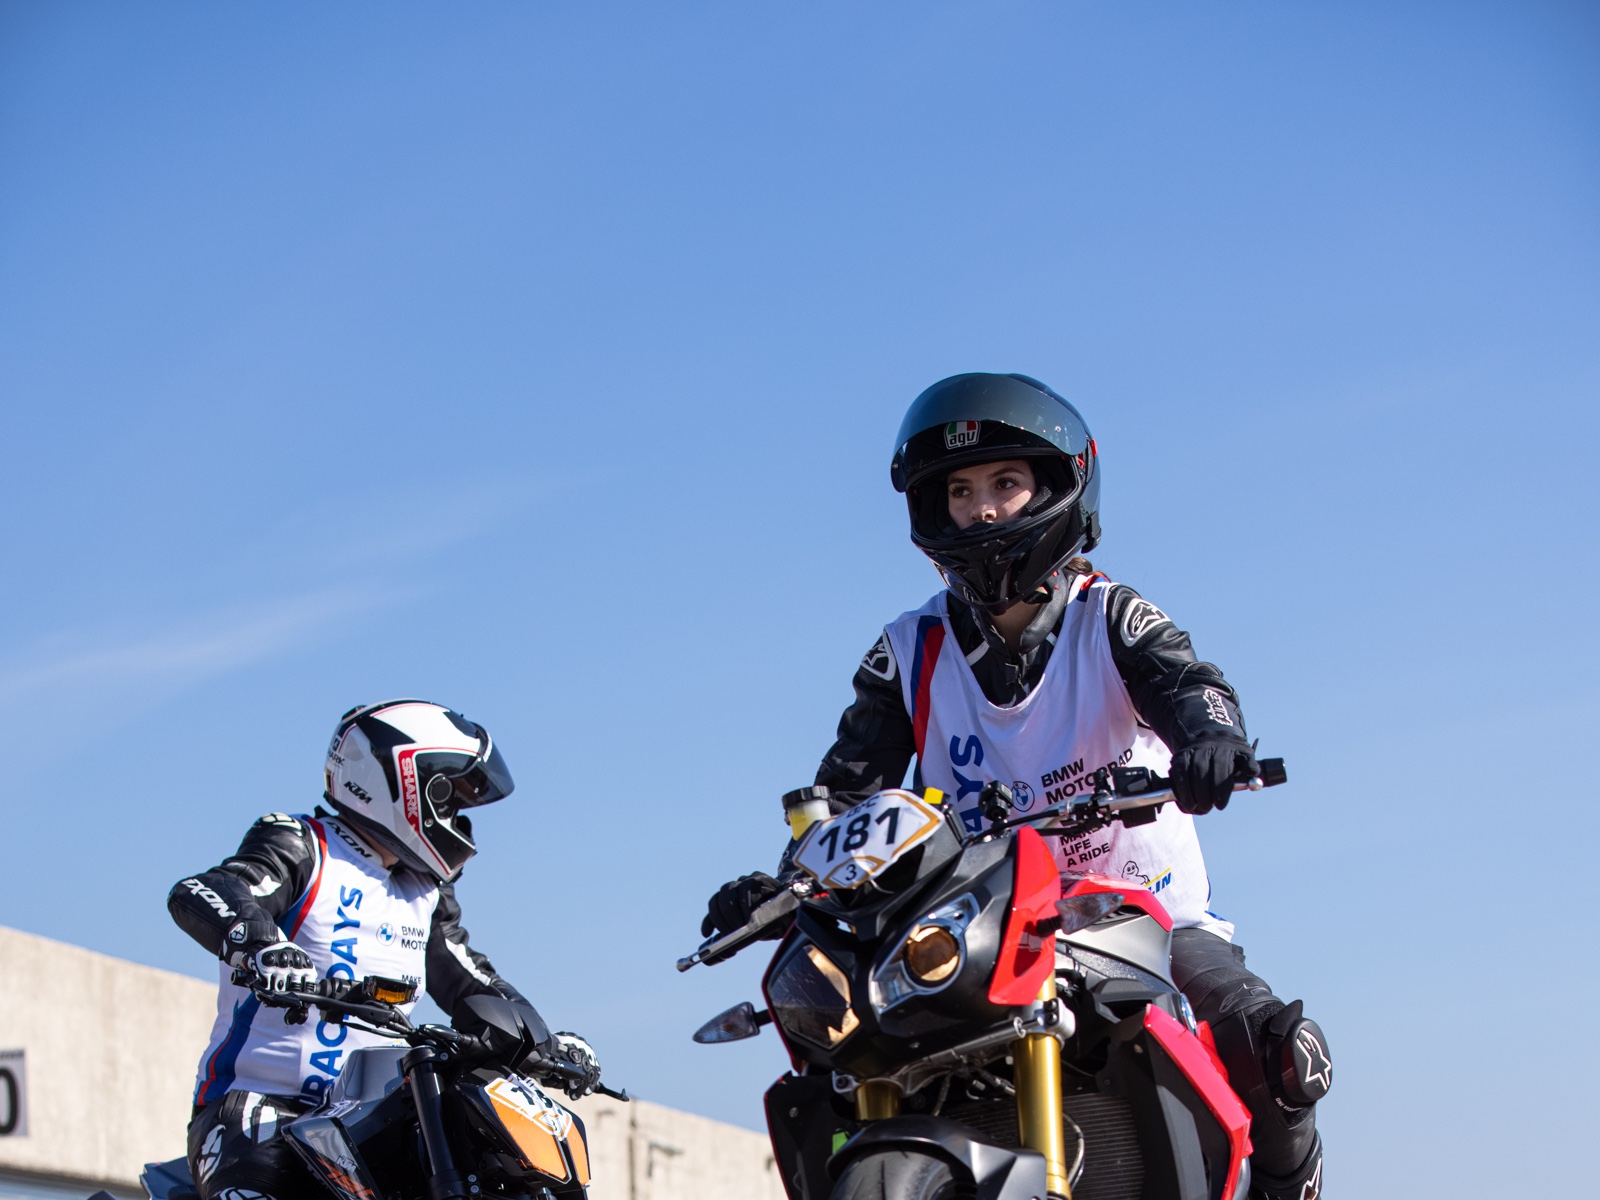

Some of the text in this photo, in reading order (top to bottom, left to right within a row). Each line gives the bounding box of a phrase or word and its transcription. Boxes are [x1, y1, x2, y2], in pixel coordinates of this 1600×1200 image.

[950, 431, 976, 446] agv
[1041, 758, 1085, 788] BMW
[344, 780, 373, 804] KTM
[401, 757, 418, 819] SHARK
[818, 807, 901, 863] 181
[1063, 839, 1092, 857] LIFE
[1067, 843, 1111, 868] A RIDE
[845, 864, 857, 881] 3
[401, 925, 425, 938] BMW
